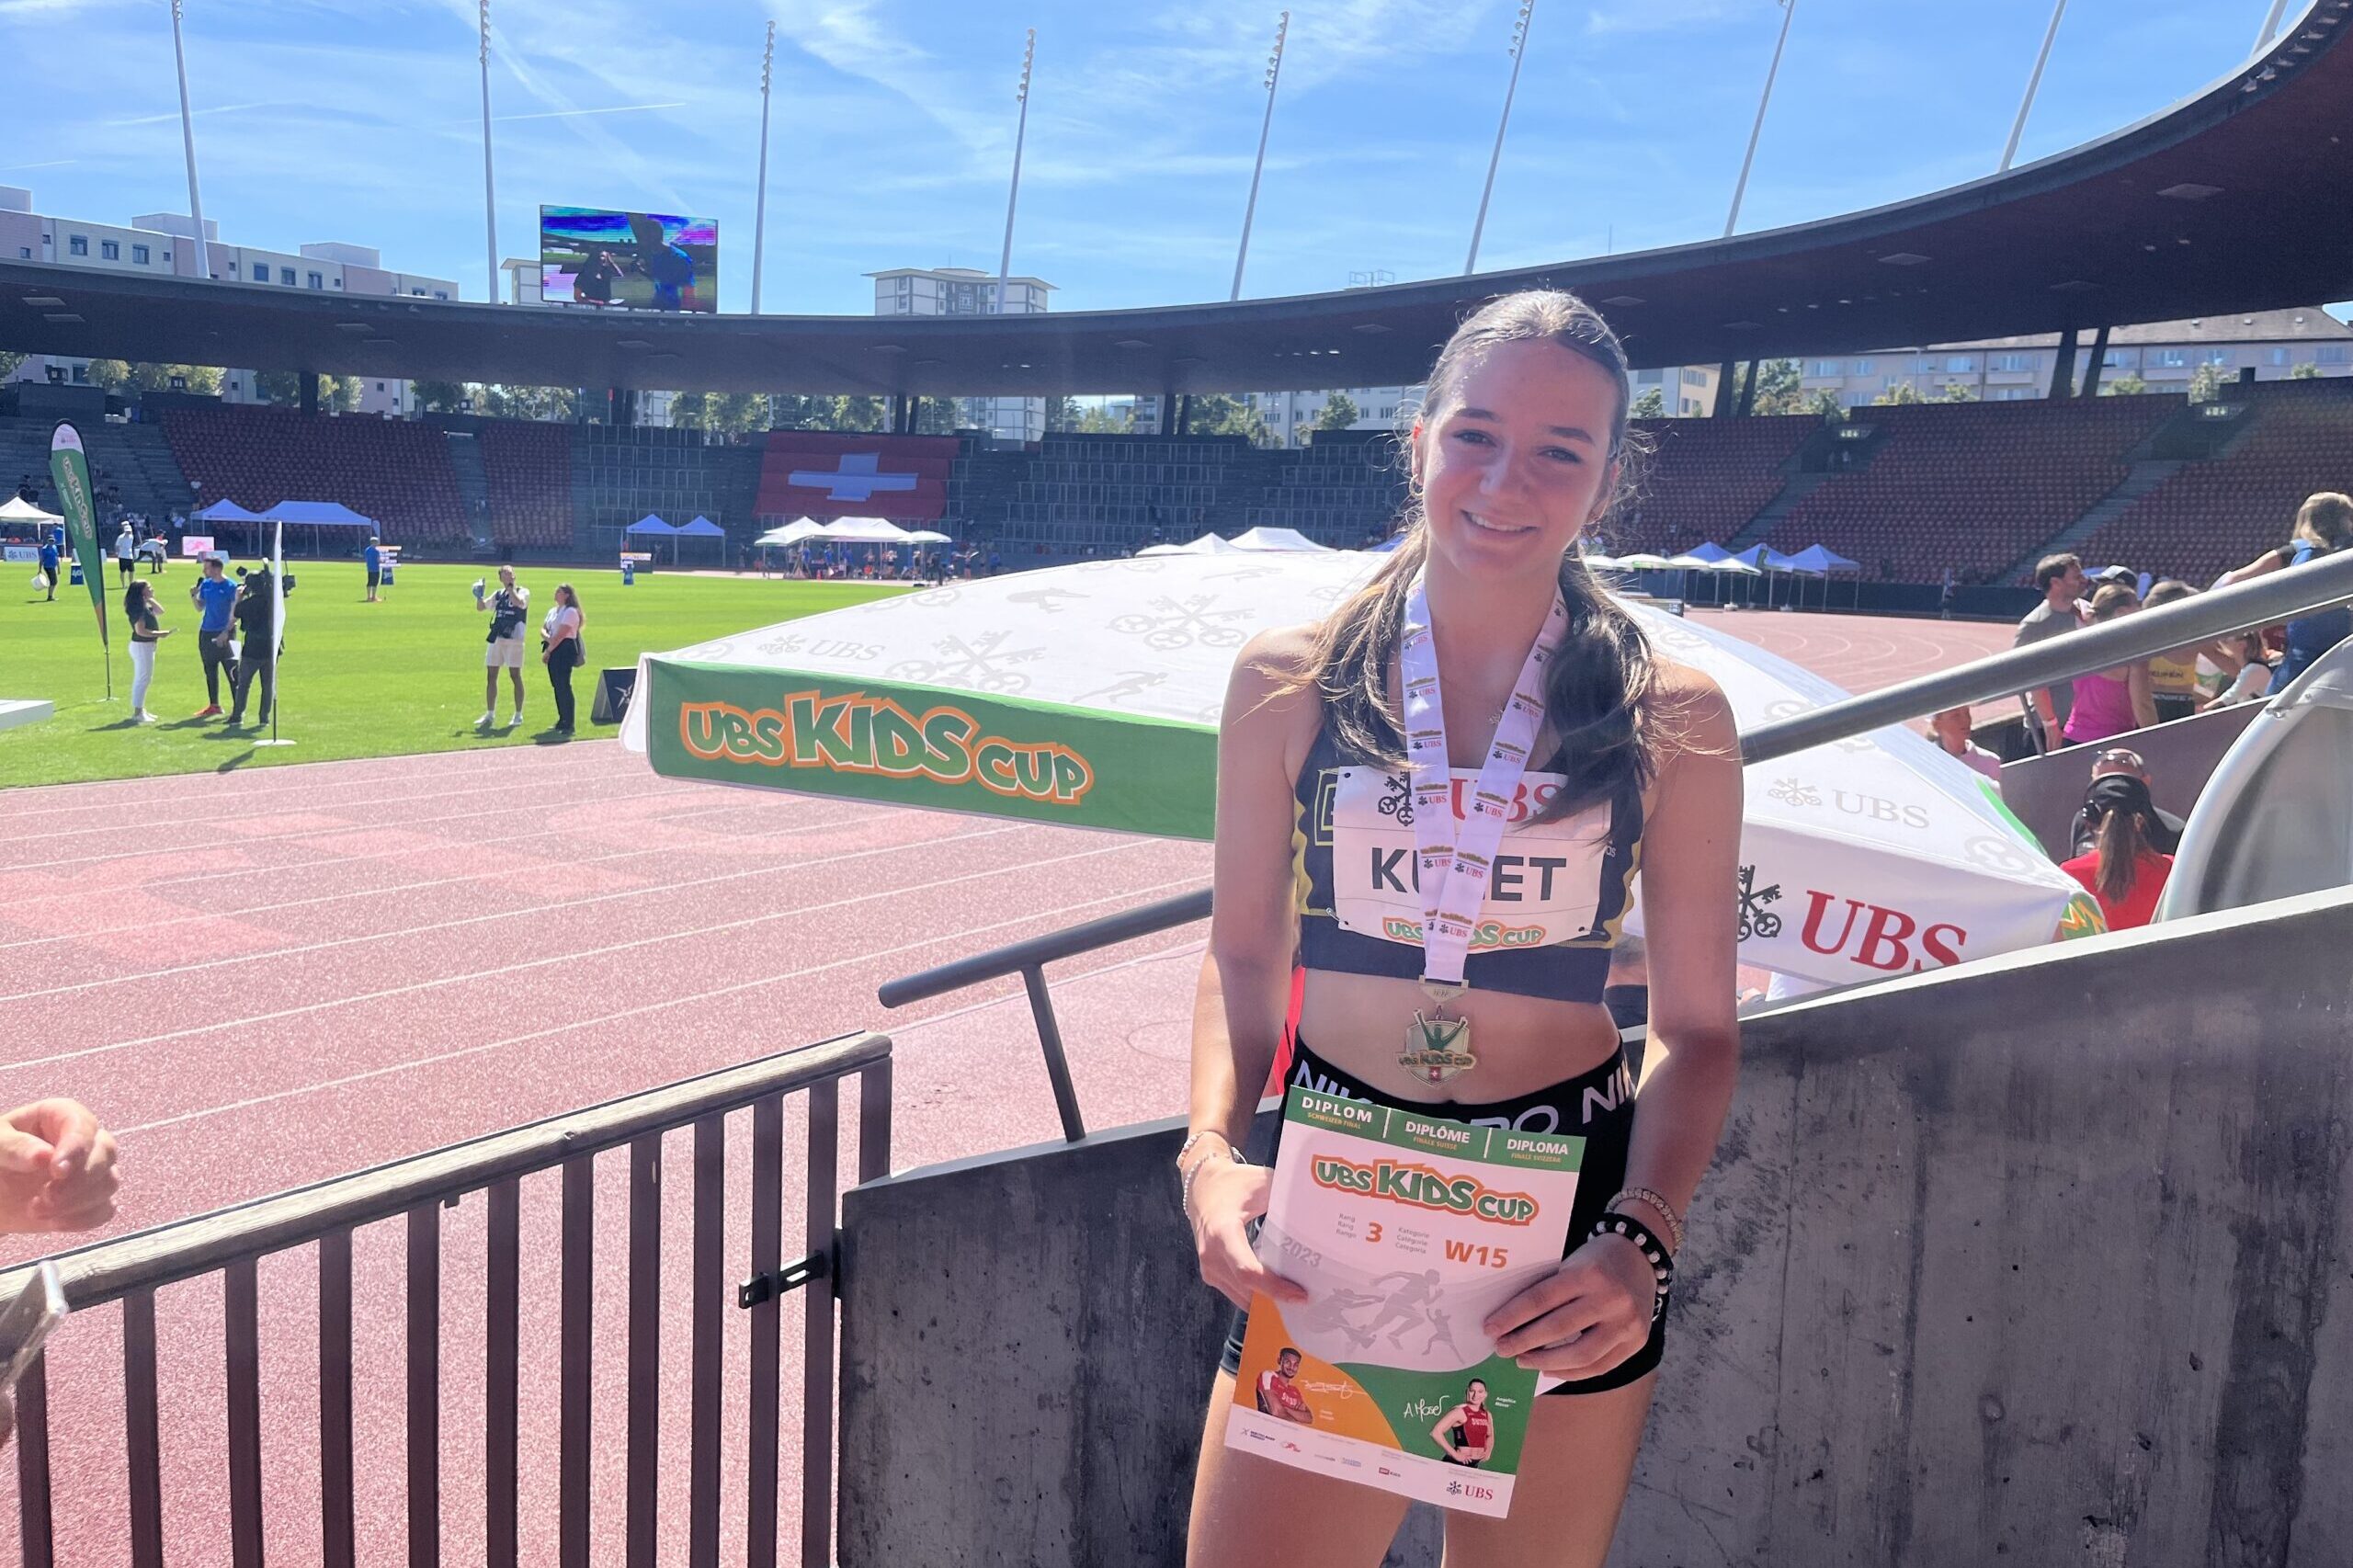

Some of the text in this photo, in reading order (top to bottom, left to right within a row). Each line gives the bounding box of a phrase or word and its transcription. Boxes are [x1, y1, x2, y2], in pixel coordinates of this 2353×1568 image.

[18, 551, 38, 560] UBS
[809, 640, 886, 661] UBS
[1418, 687, 1436, 698] UBS
[1521, 706, 1540, 719] UBS
[686, 696, 1089, 801] UBS KIDS CUP
[1424, 739, 1442, 748] UBS
[1503, 752, 1521, 764] UBS
[1428, 795, 1448, 804] UBS
[1484, 805, 1504, 818] UBS
[1832, 789, 1931, 829] UBS
[1371, 847, 1567, 902] KET
[1465, 866, 1484, 879] UBS
[1449, 927, 1469, 938] UBS
[1502, 929, 1542, 945] CUP
[1800, 890, 1967, 972] UBS
[1302, 1096, 1372, 1123] DIPLOM
[1404, 1120, 1471, 1143] DIPLÔME
[1506, 1138, 1568, 1155] DIPLOMA
[1316, 1161, 1534, 1221] UBS KIDS CUP
[1365, 1221, 1383, 1243] 3
[1280, 1236, 1323, 1267] 2023
[1445, 1239, 1509, 1268] W15
[1464, 1484, 1494, 1501] UBS
